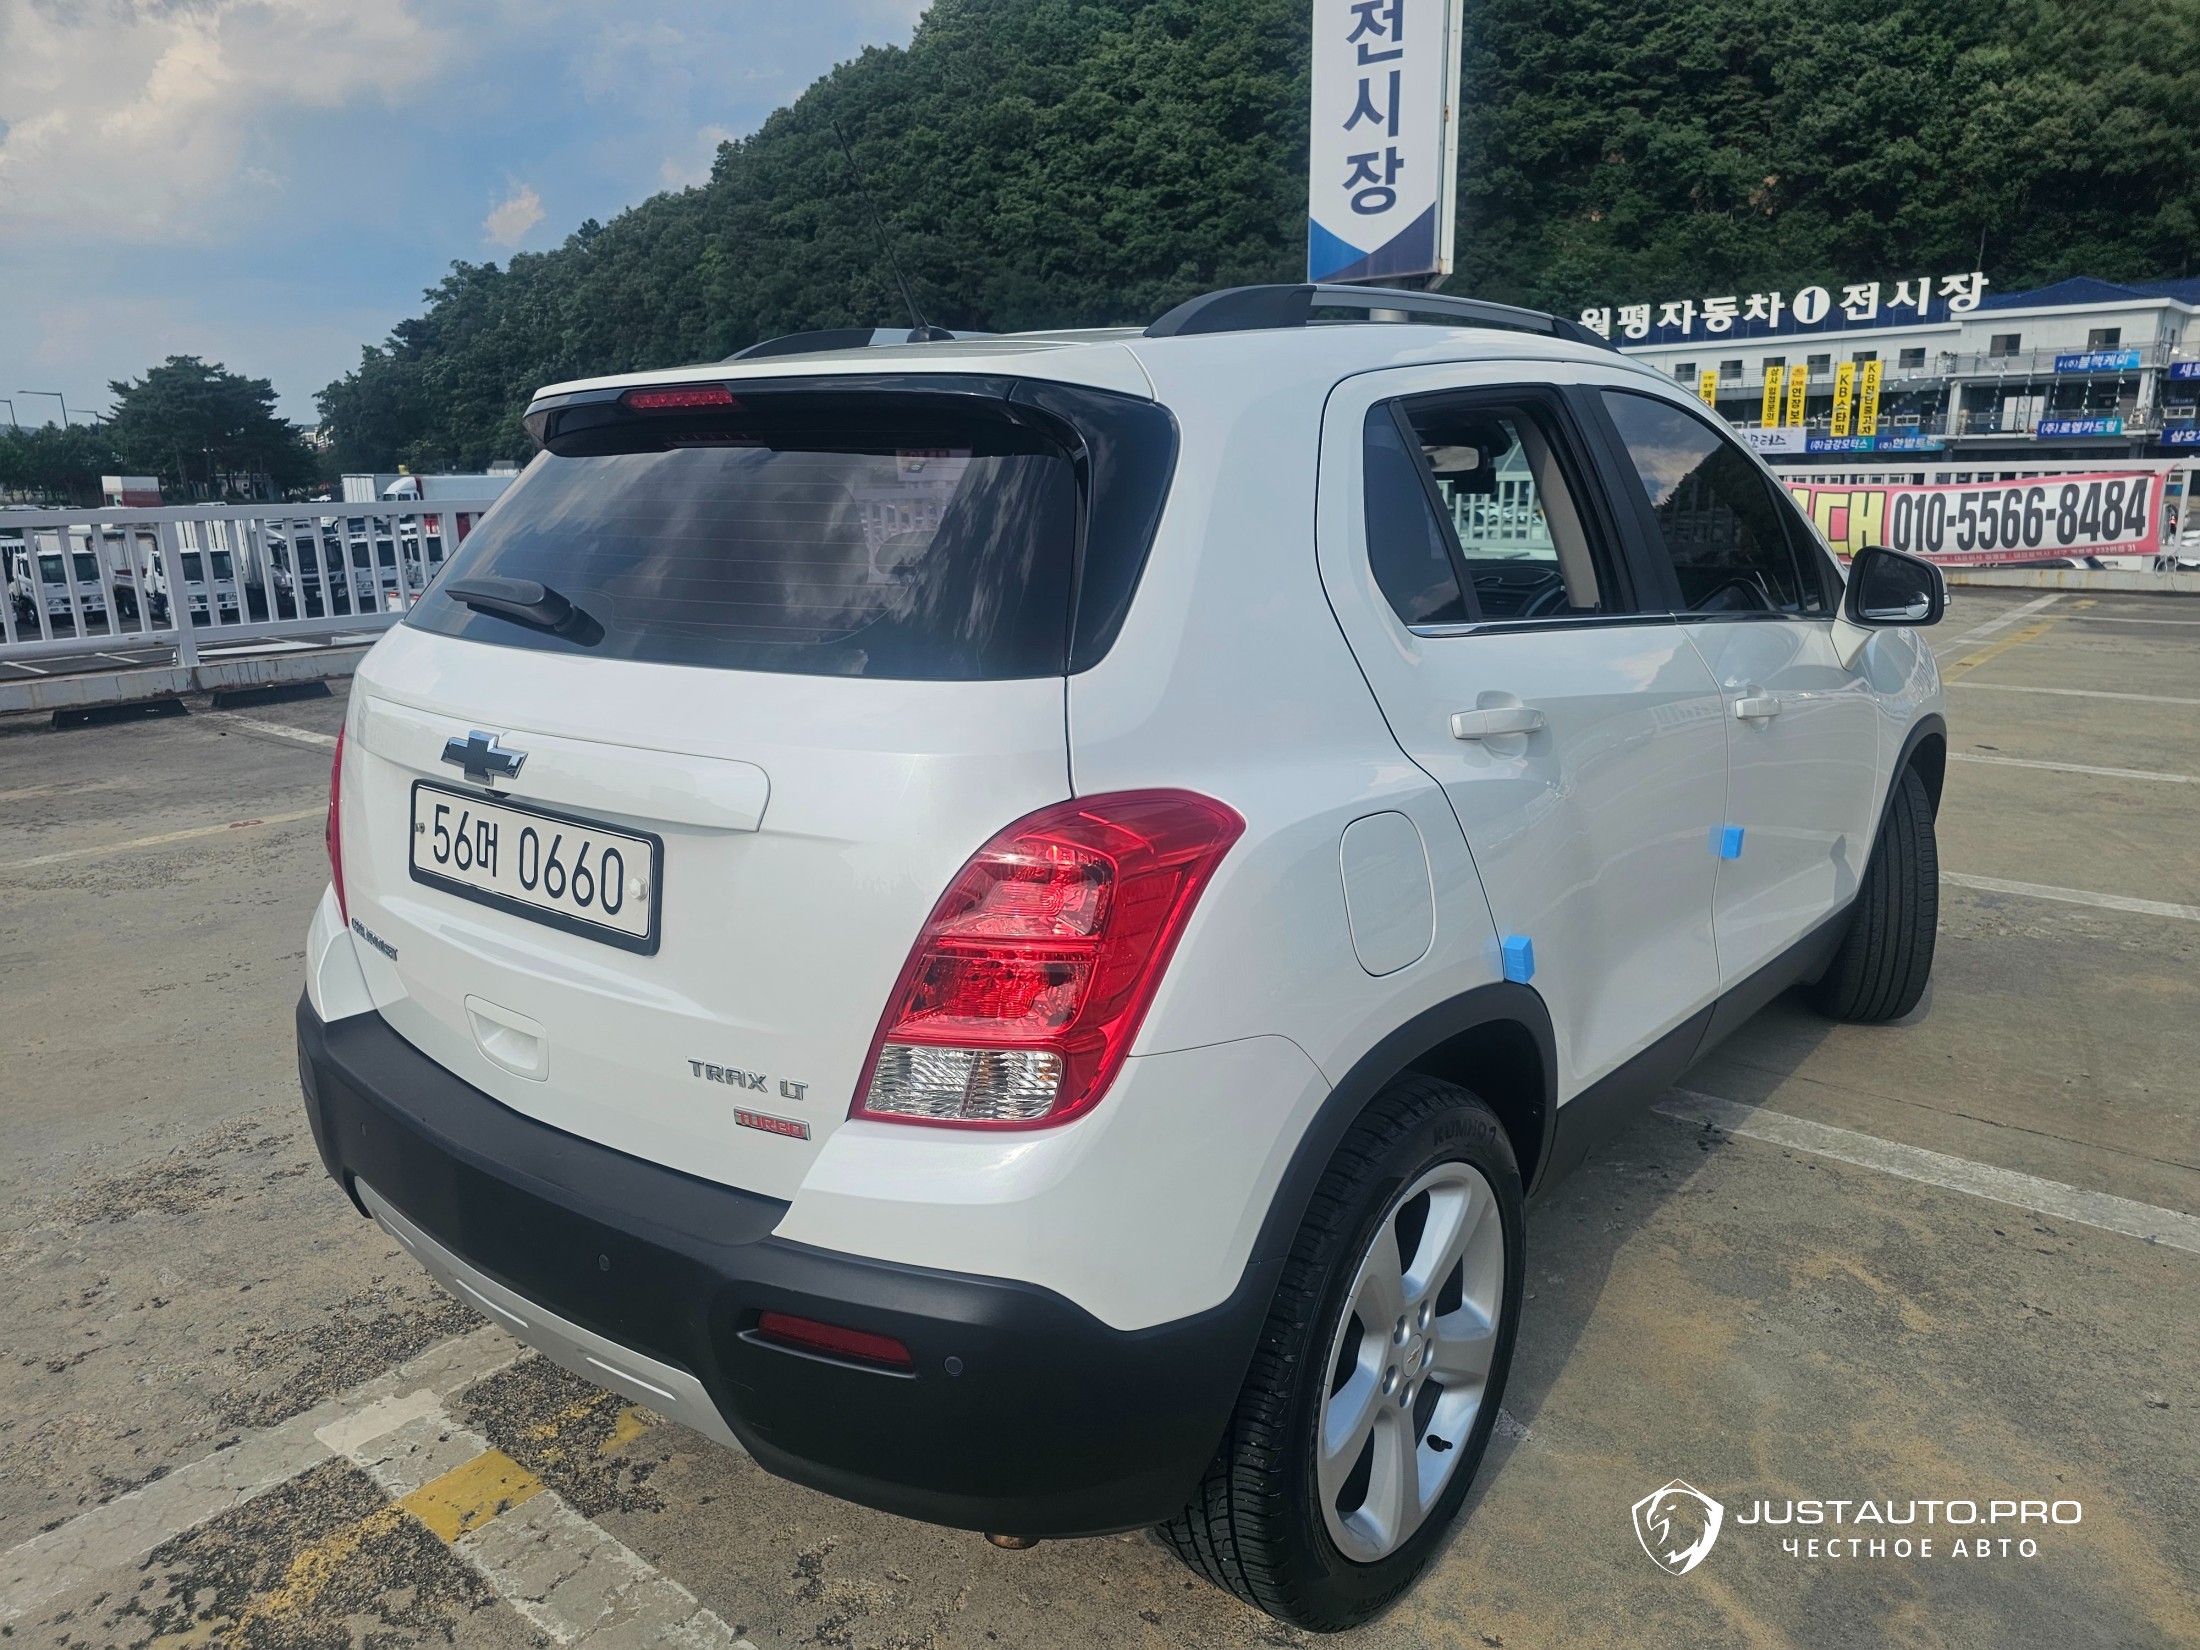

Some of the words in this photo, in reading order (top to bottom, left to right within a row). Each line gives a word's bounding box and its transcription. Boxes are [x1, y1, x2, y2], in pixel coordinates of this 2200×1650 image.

[1342, 0, 1405, 216] 전시장
[1892, 478, 2148, 552] 010-5566-8484
[432, 804, 498, 878] 56머
[518, 826, 624, 916] 0660
[687, 1058, 768, 1093] TRAX
[779, 1079, 808, 1101] LT
[735, 1109, 805, 1139] TURBO
